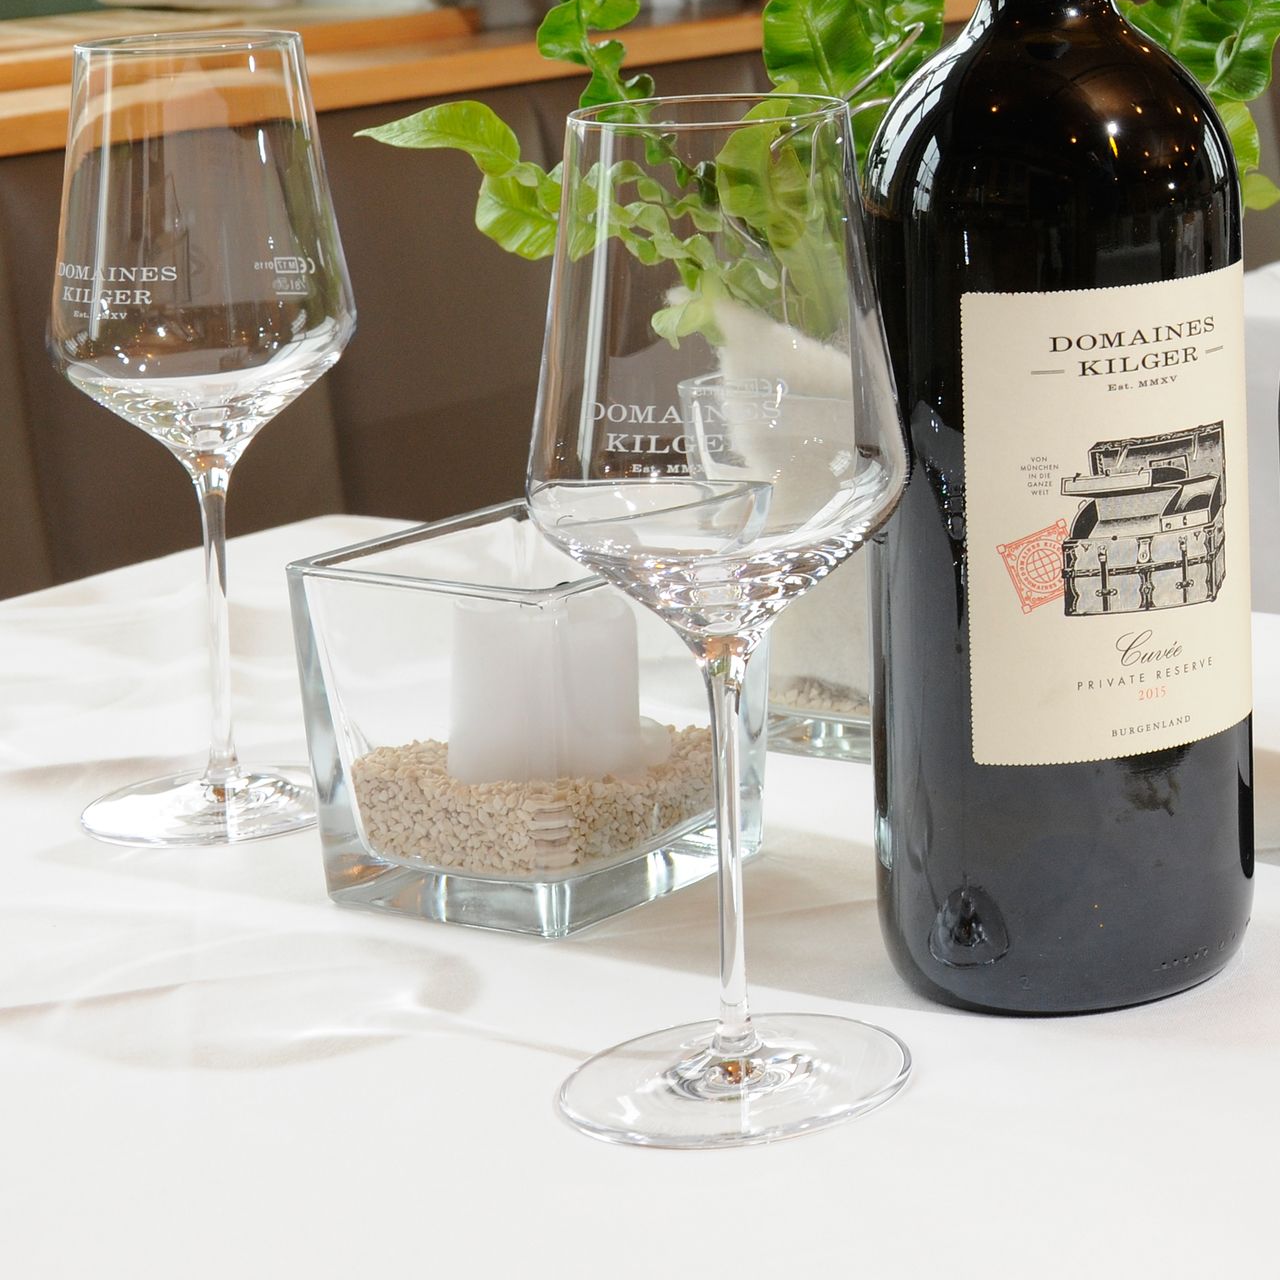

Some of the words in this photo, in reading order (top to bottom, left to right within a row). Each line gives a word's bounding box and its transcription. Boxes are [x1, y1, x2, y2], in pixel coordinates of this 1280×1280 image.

[58, 262, 178, 281] DOMAINES
[63, 286, 152, 305] KILGER
[95, 312, 128, 320] MXV
[1049, 316, 1215, 353] DOMAINES
[1078, 346, 1199, 377] KILGER
[1107, 382, 1134, 392] Est.
[1138, 375, 1178, 389] MMXV
[587, 401, 781, 424] DOMAINS
[1115, 629, 1183, 667] Cuvée
[1077, 672, 1145, 691] PRIVATE
[1156, 656, 1213, 680] RESERVE
[1138, 686, 1168, 701] 2015
[1111, 715, 1192, 738] BURGENLAND
